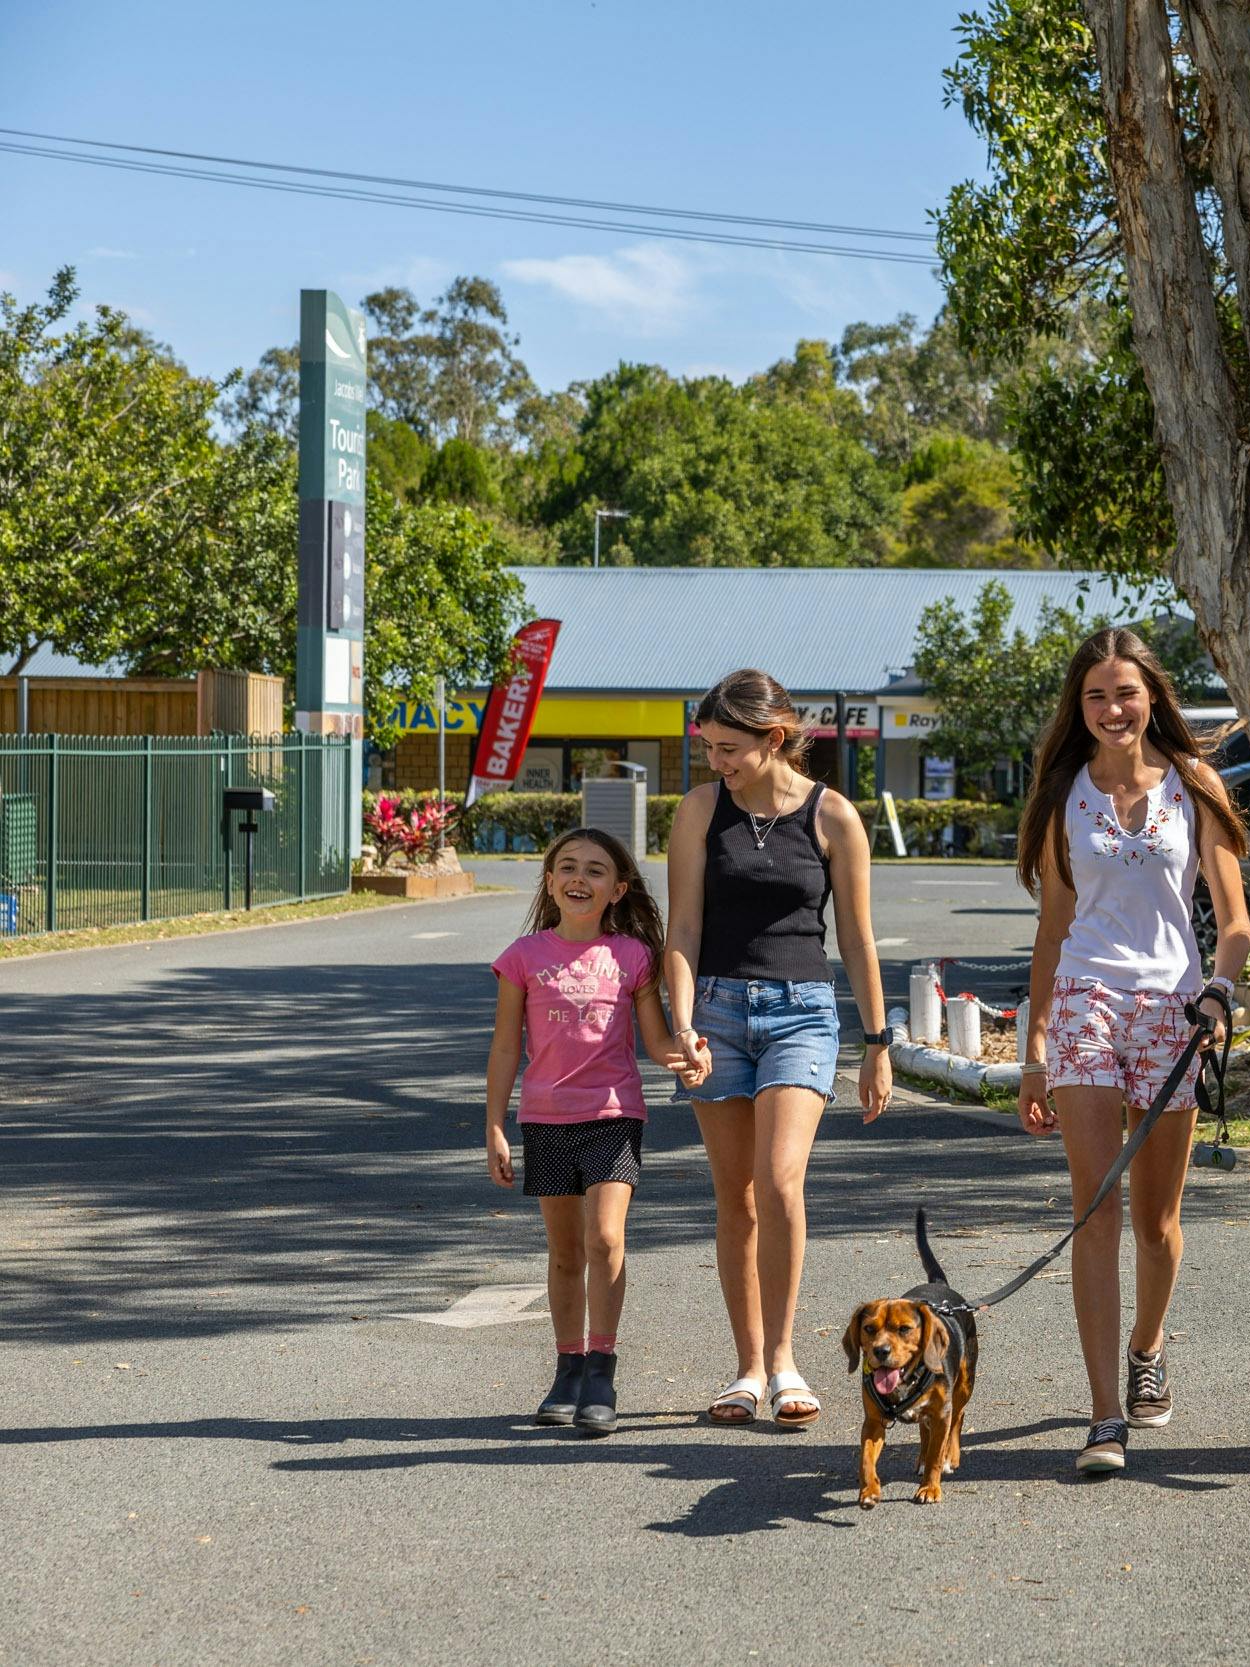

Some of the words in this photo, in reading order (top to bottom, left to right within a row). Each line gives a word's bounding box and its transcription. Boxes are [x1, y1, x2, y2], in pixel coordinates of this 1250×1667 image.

[362, 701, 485, 729] MACY
[526, 767, 551, 778] INNER
[536, 963, 564, 986] MY
[570, 959, 628, 985] AUNT
[562, 984, 596, 994] LOVES
[548, 1009, 570, 1023] ME
[578, 1009, 614, 1024] LOTS
